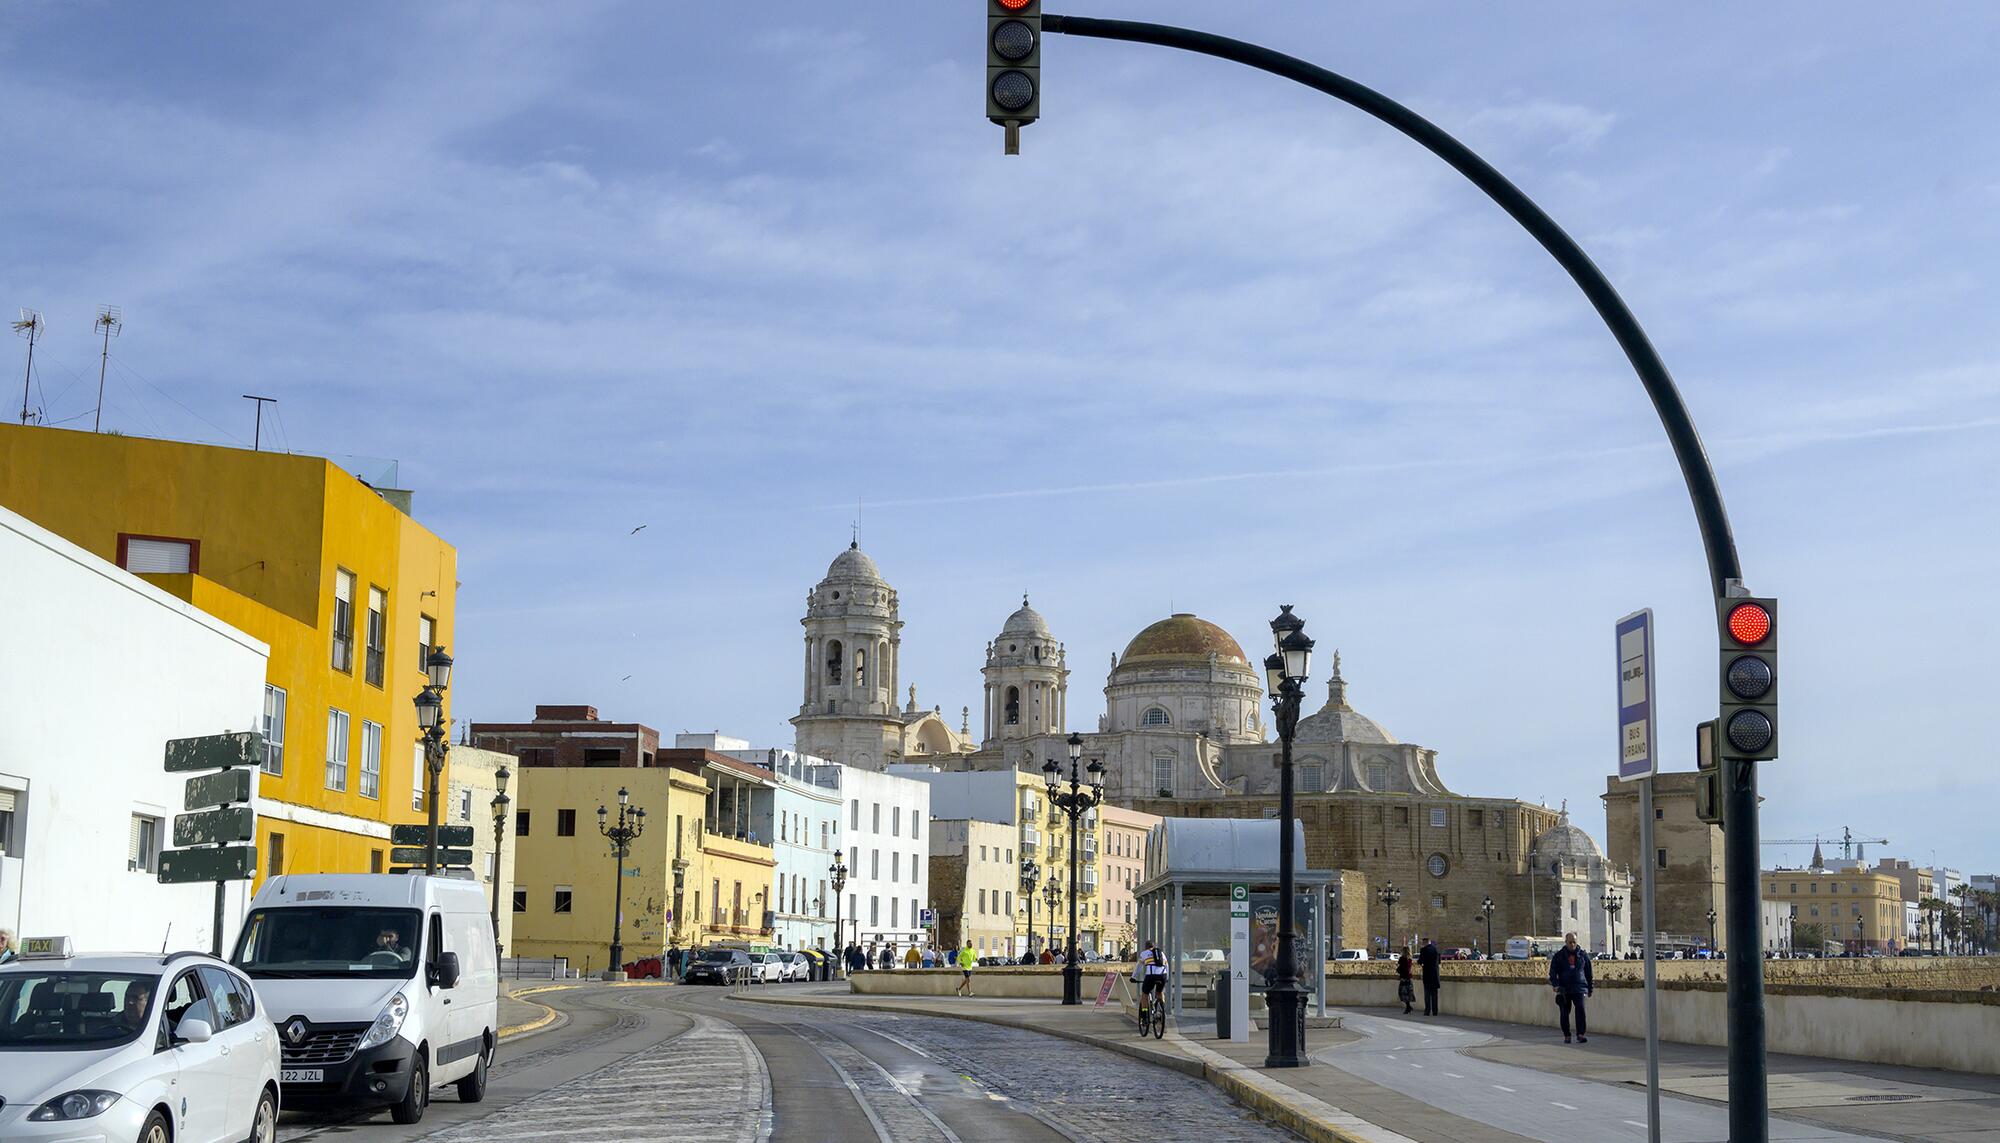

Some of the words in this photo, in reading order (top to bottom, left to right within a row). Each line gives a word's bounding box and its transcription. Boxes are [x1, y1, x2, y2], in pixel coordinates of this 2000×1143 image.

[1629, 727, 1640, 740] BUS
[31, 940, 51, 951] TAXI
[280, 1071, 298, 1081] 122
[301, 1070, 321, 1081] JZL
